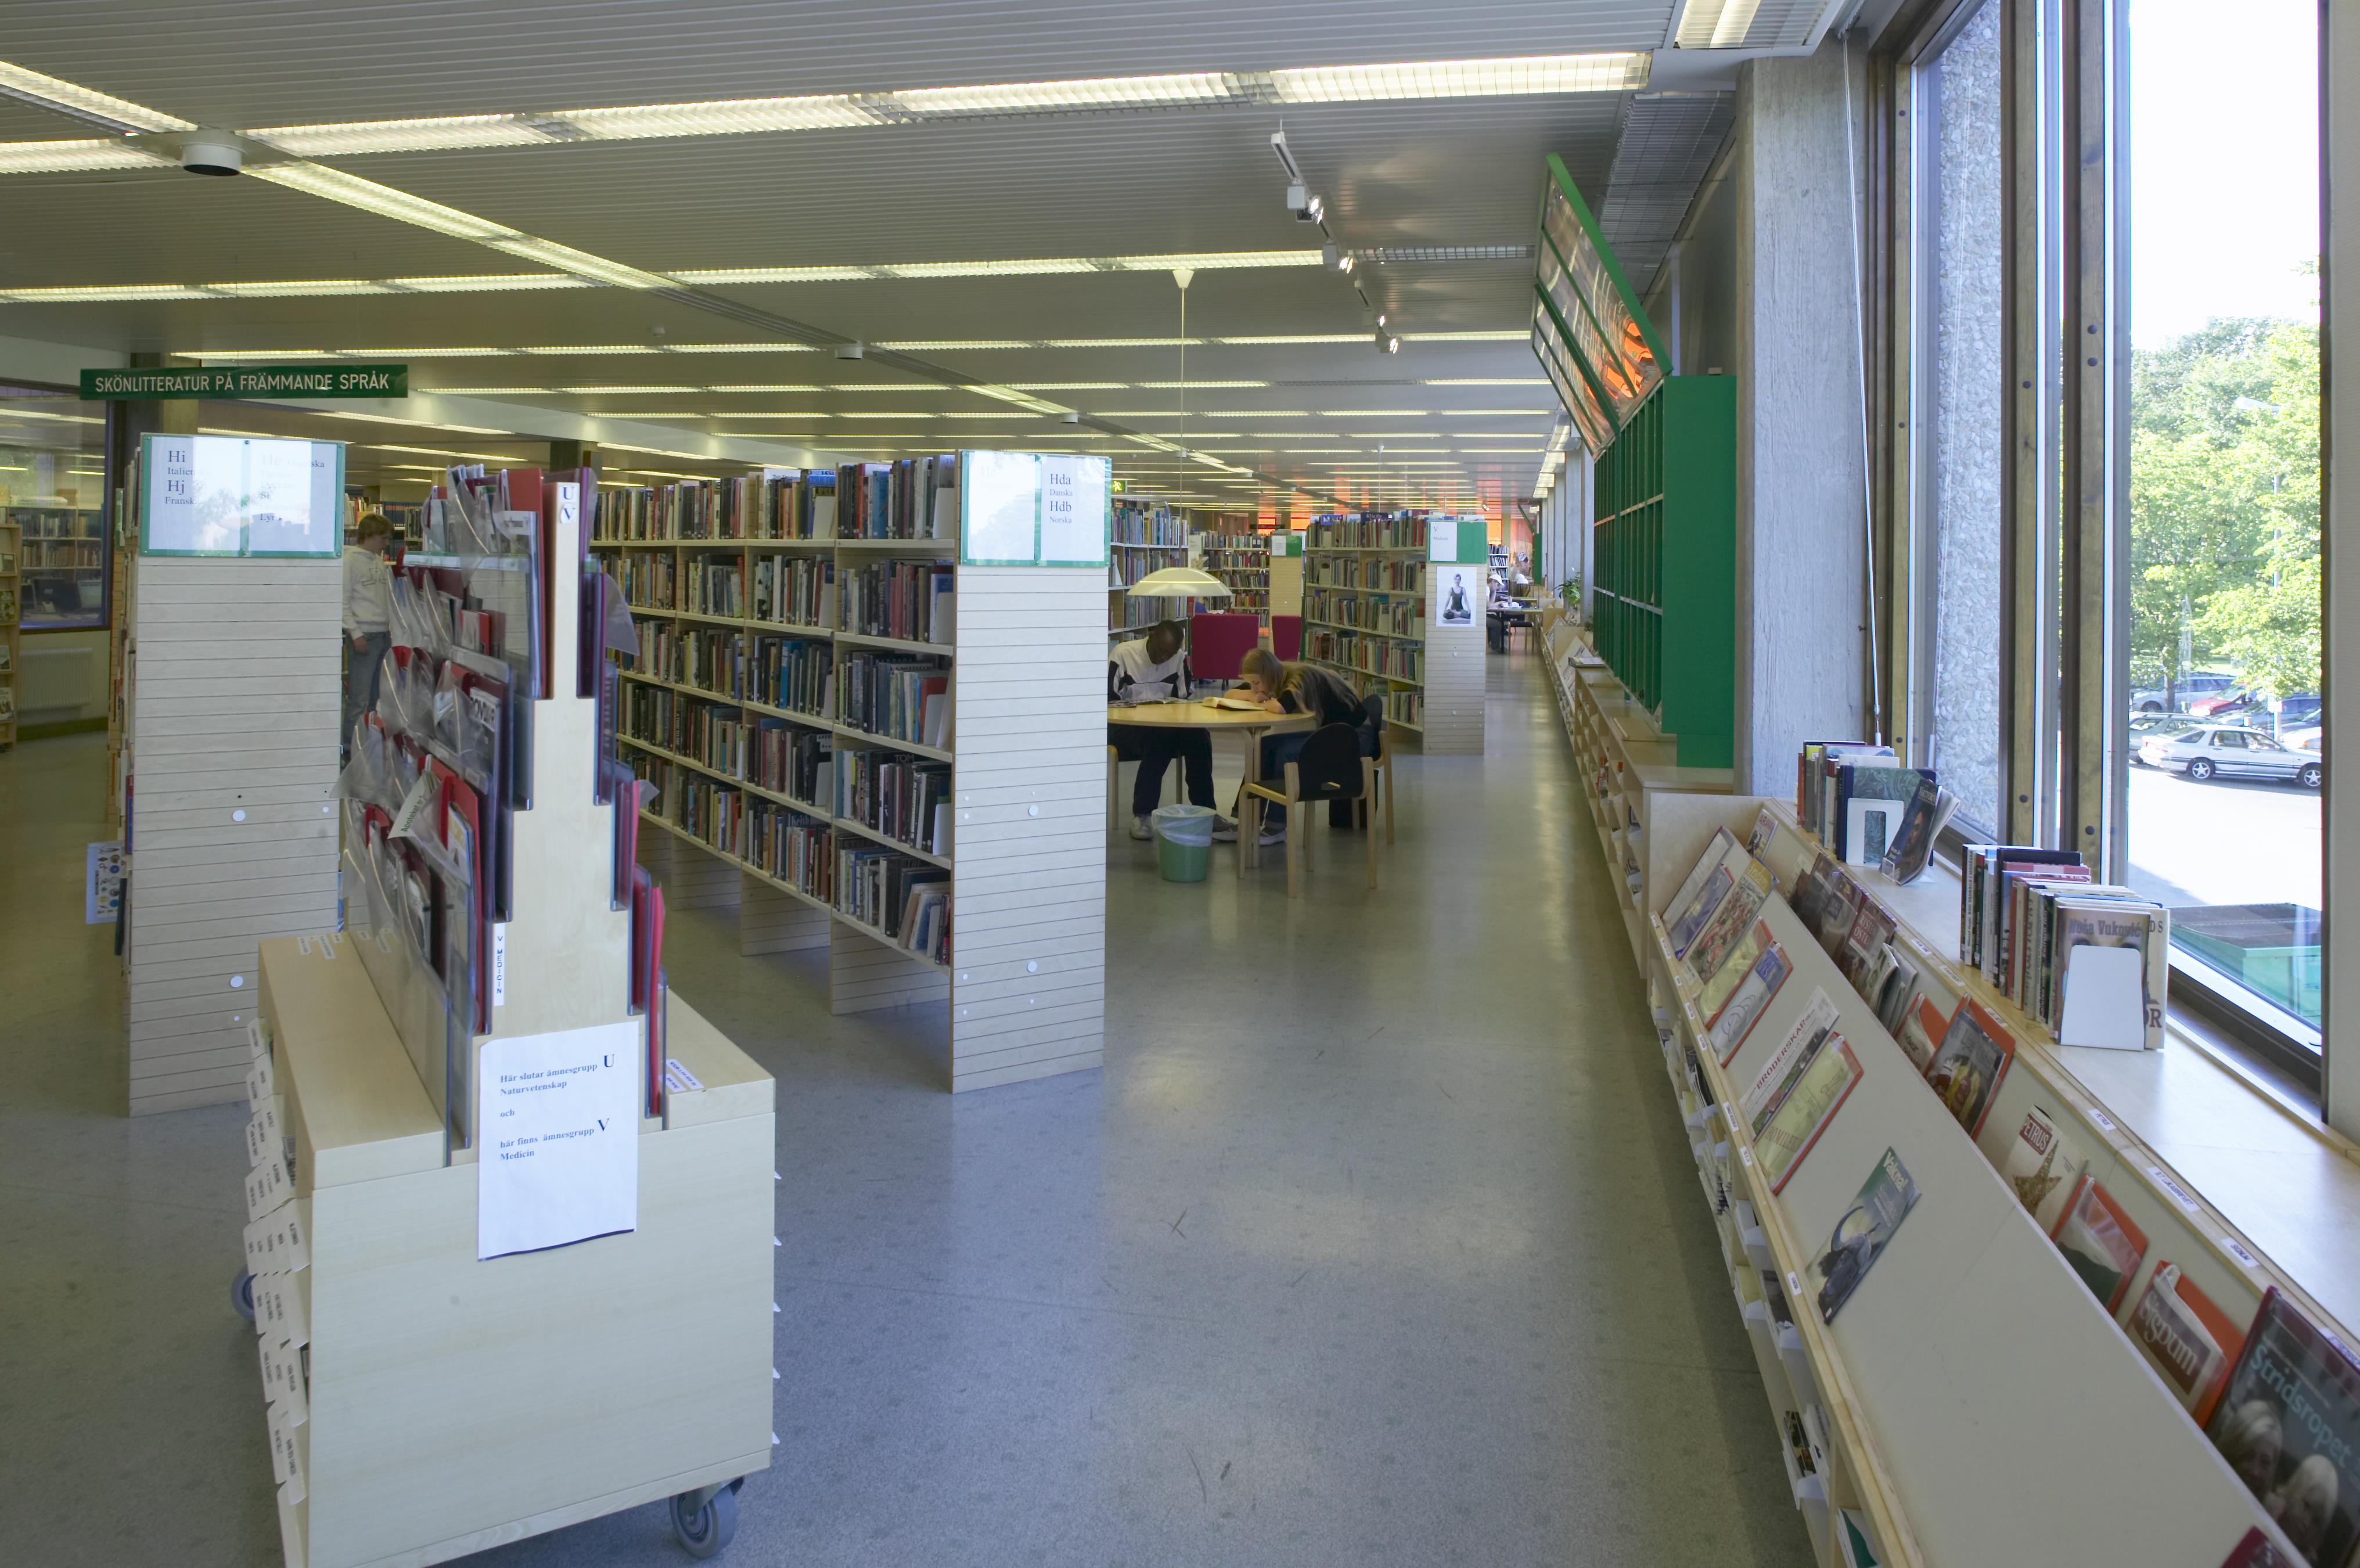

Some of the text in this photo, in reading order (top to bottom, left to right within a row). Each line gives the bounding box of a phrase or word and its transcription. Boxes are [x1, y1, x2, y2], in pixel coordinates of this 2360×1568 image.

[95, 371, 389, 393] SKÖNLITTERATUR PÅ FRÄMMANDE SPRÅK
[168, 450, 186, 462] Hi
[1050, 473, 1071, 485] Hda
[167, 480, 185, 495] Hj
[563, 487, 575, 500] U
[165, 497, 200, 505] Fransk
[1050, 501, 1071, 512] Hdb
[563, 508, 575, 520] V
[1755, 1018, 1807, 1090] BRODERSKAP
[500, 1053, 615, 1084] Här slutar ämnesgrupp U
[500, 1081, 567, 1096] Naturvetenskap
[500, 1109, 515, 1117] och
[500, 1118, 610, 1148] här finns ämnesgrupp V
[500, 1149, 535, 1161] Medicin
[2139, 1290, 2198, 1376] Signum
[2250, 1343, 2351, 1469] Stridsropet
